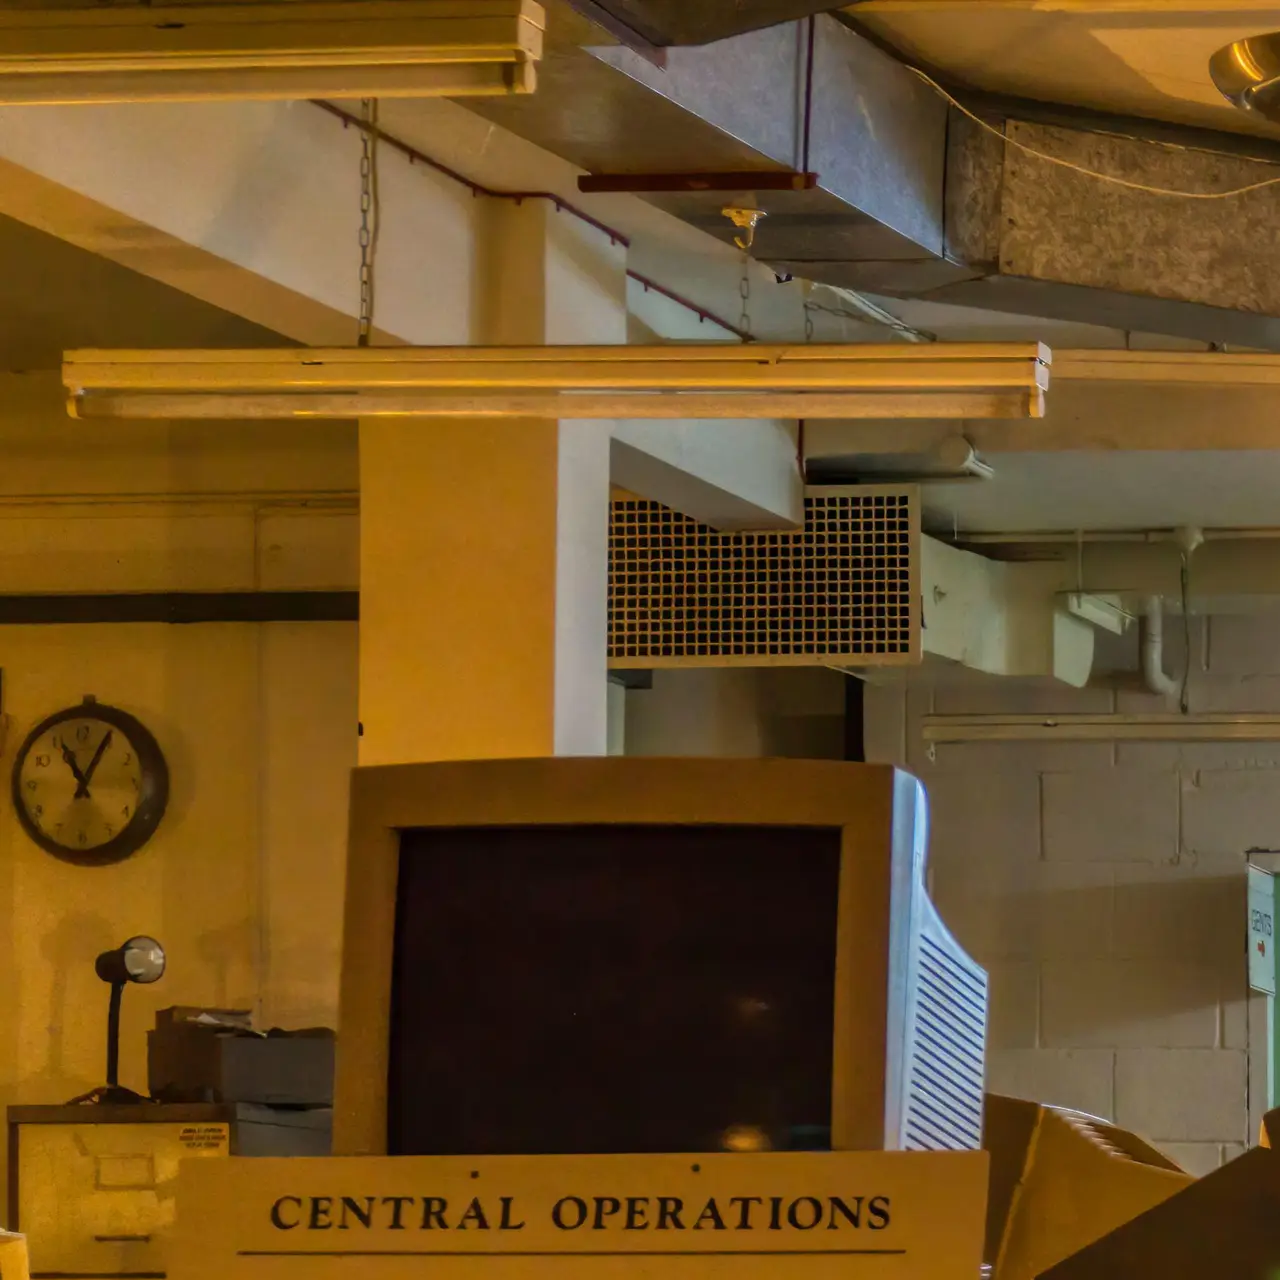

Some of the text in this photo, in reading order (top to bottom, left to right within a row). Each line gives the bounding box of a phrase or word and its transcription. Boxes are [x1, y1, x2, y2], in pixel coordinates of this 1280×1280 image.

[35, 754, 50, 767] 10
[270, 1196, 891, 1230] CENTRAL OPERATIONS
